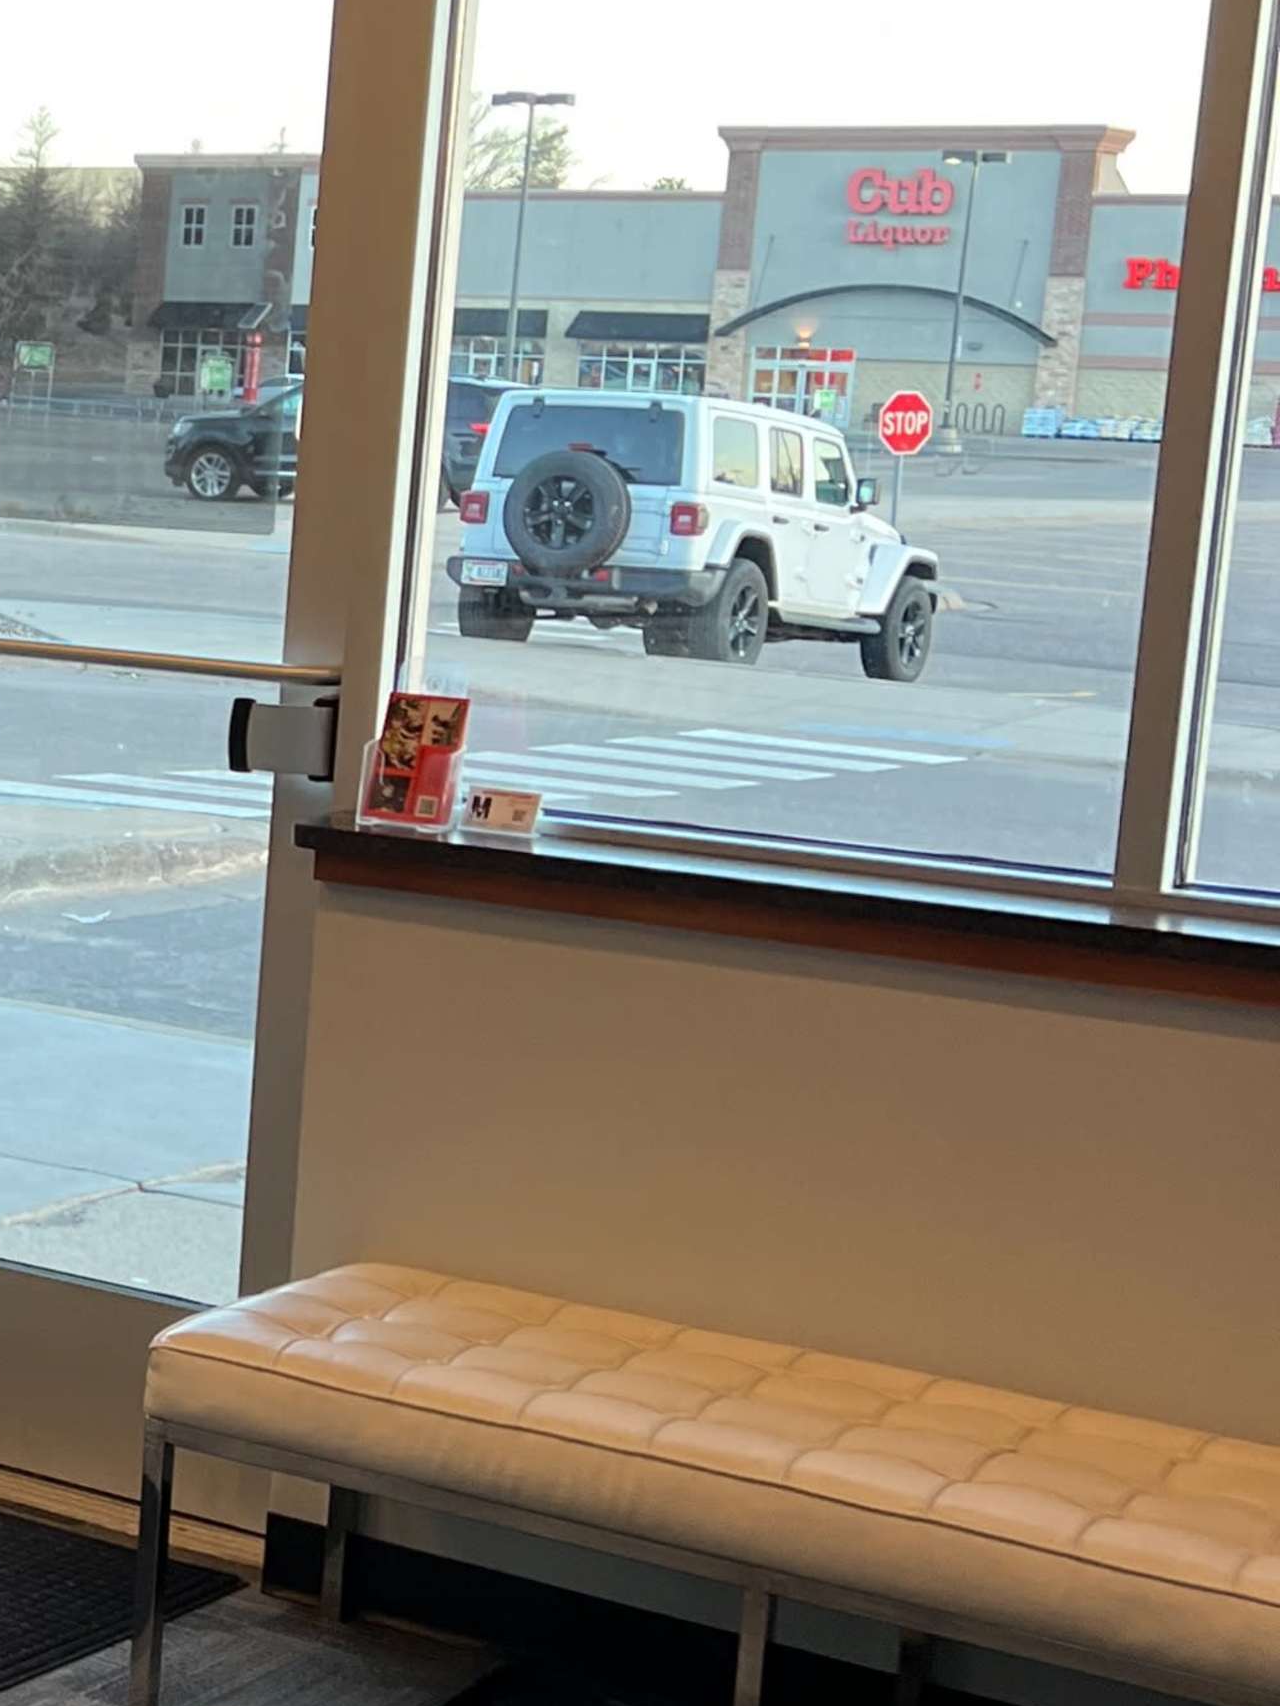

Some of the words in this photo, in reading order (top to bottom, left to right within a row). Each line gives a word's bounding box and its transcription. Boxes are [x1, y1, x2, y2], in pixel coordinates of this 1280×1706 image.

[847, 166, 954, 215] Cub
[848, 218, 951, 251] Liquor
[883, 410, 929, 436] STOP
